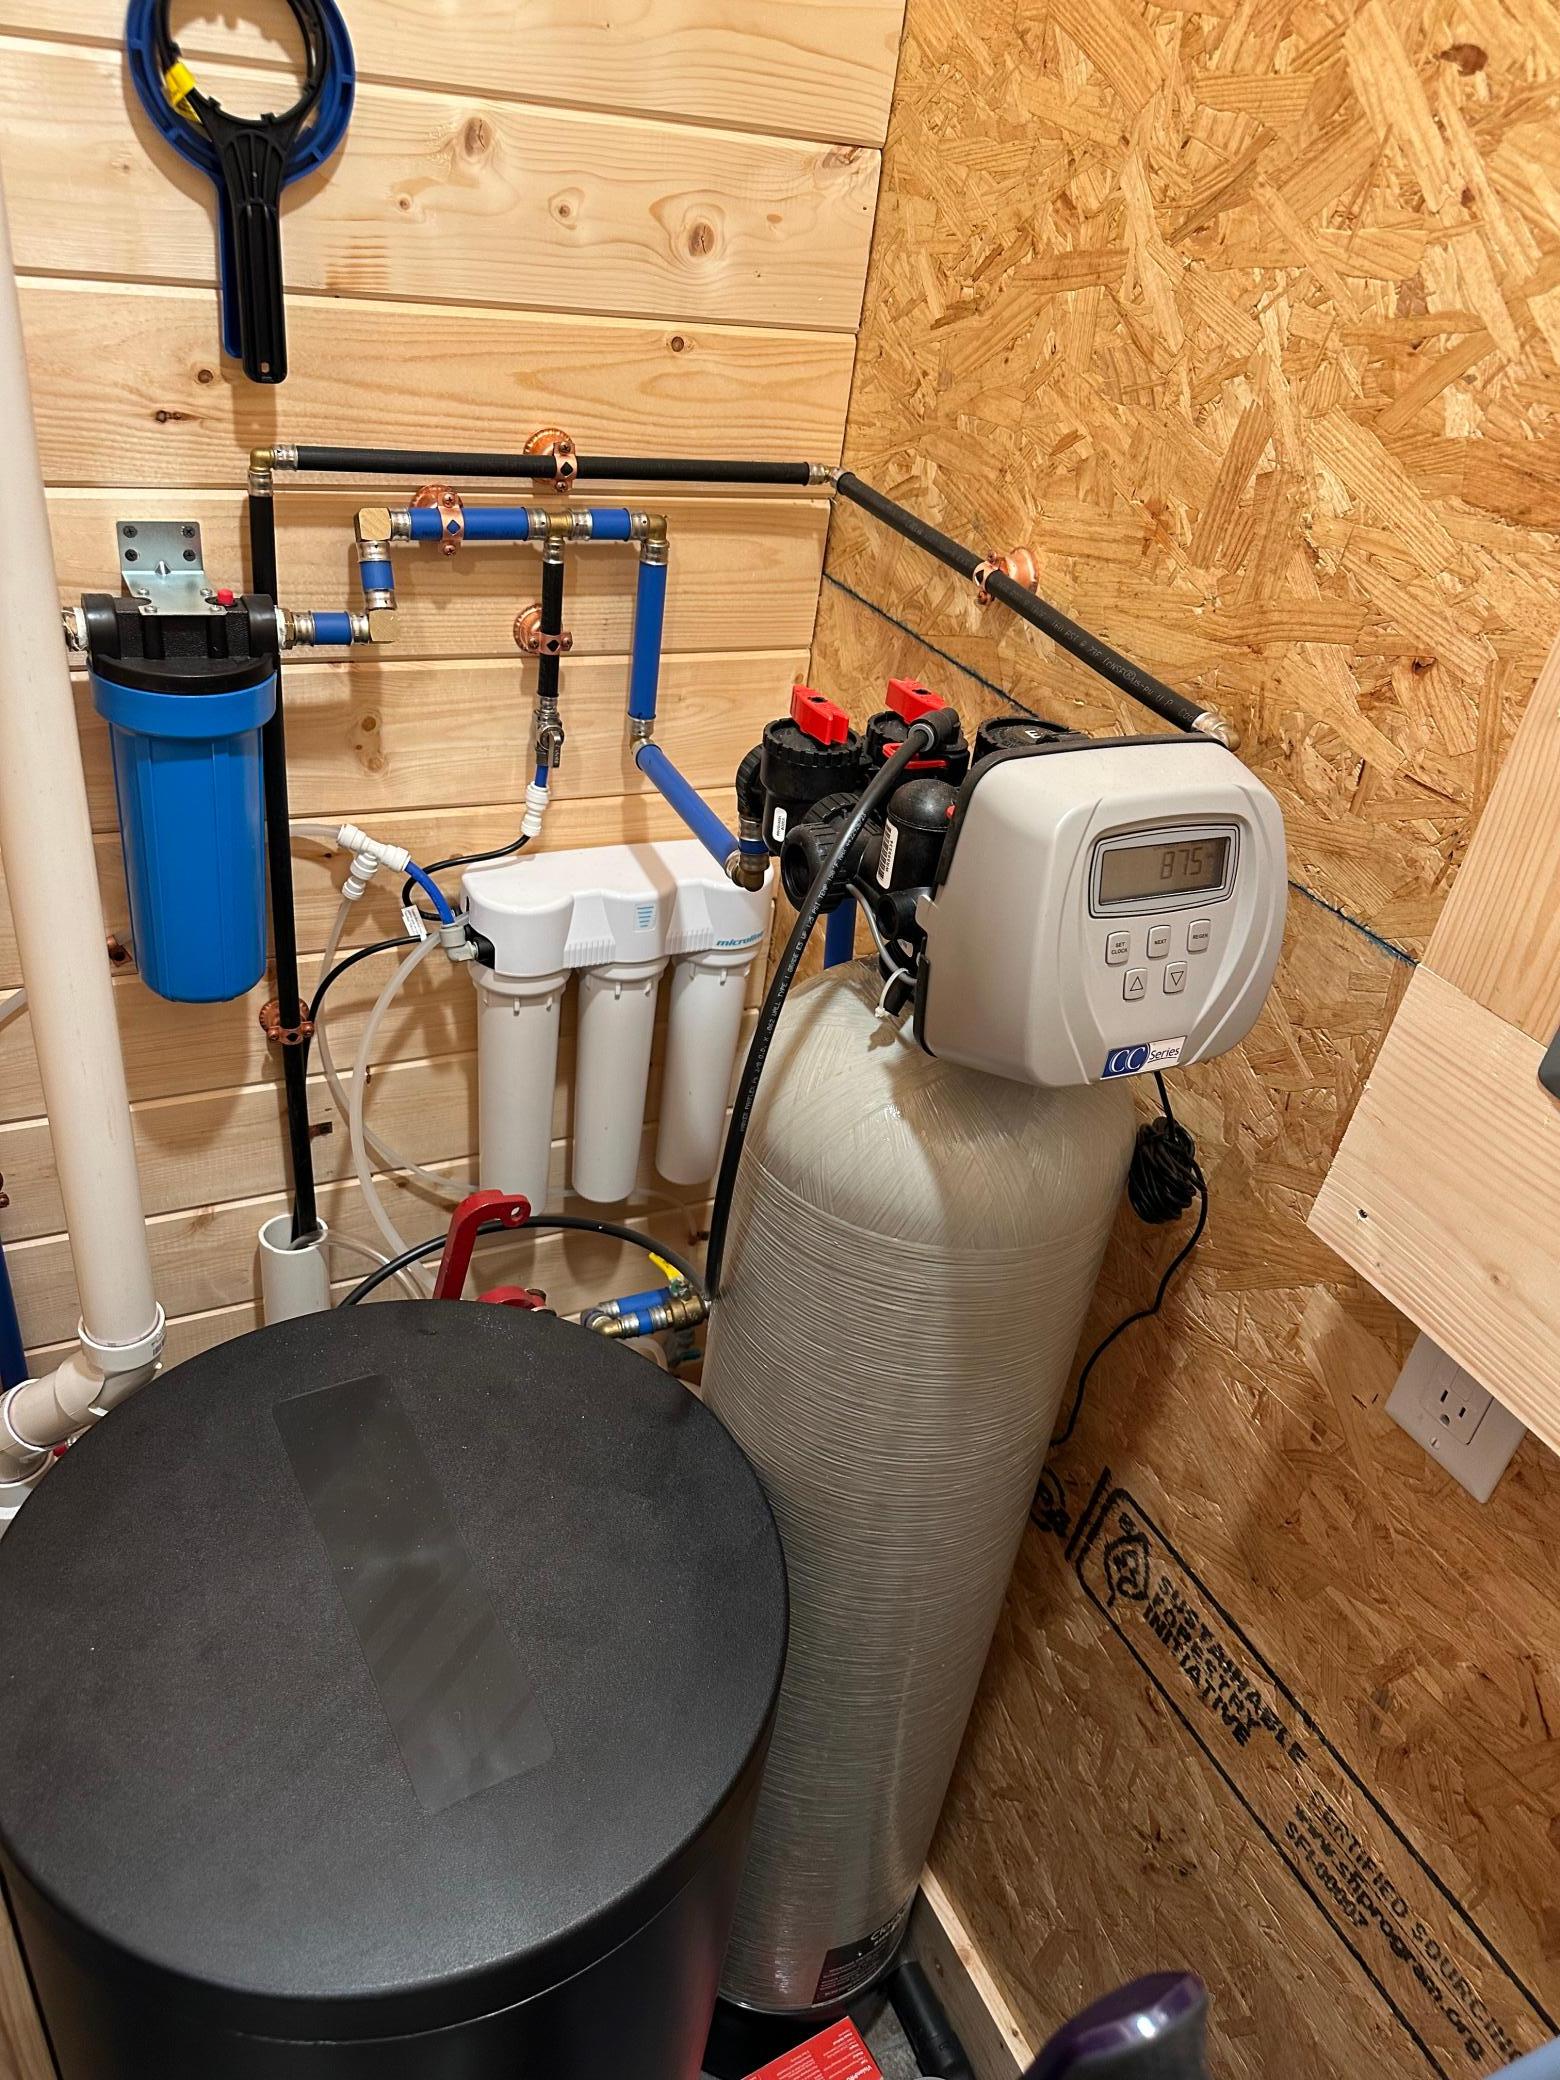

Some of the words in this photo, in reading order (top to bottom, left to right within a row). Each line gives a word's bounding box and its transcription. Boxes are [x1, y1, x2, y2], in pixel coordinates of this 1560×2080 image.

[1160, 848, 1203, 880] 875
[776, 981, 788, 998] TYPE
[810, 901, 821, 914] PSI
[1109, 1047, 1145, 1072] CC
[1150, 1047, 1180, 1060] Series
[1143, 1603, 1250, 1747] INITIATIVE
[1151, 1592, 1261, 1730] FORESTRY
[1305, 1792, 1408, 1919] CERTIFIED
